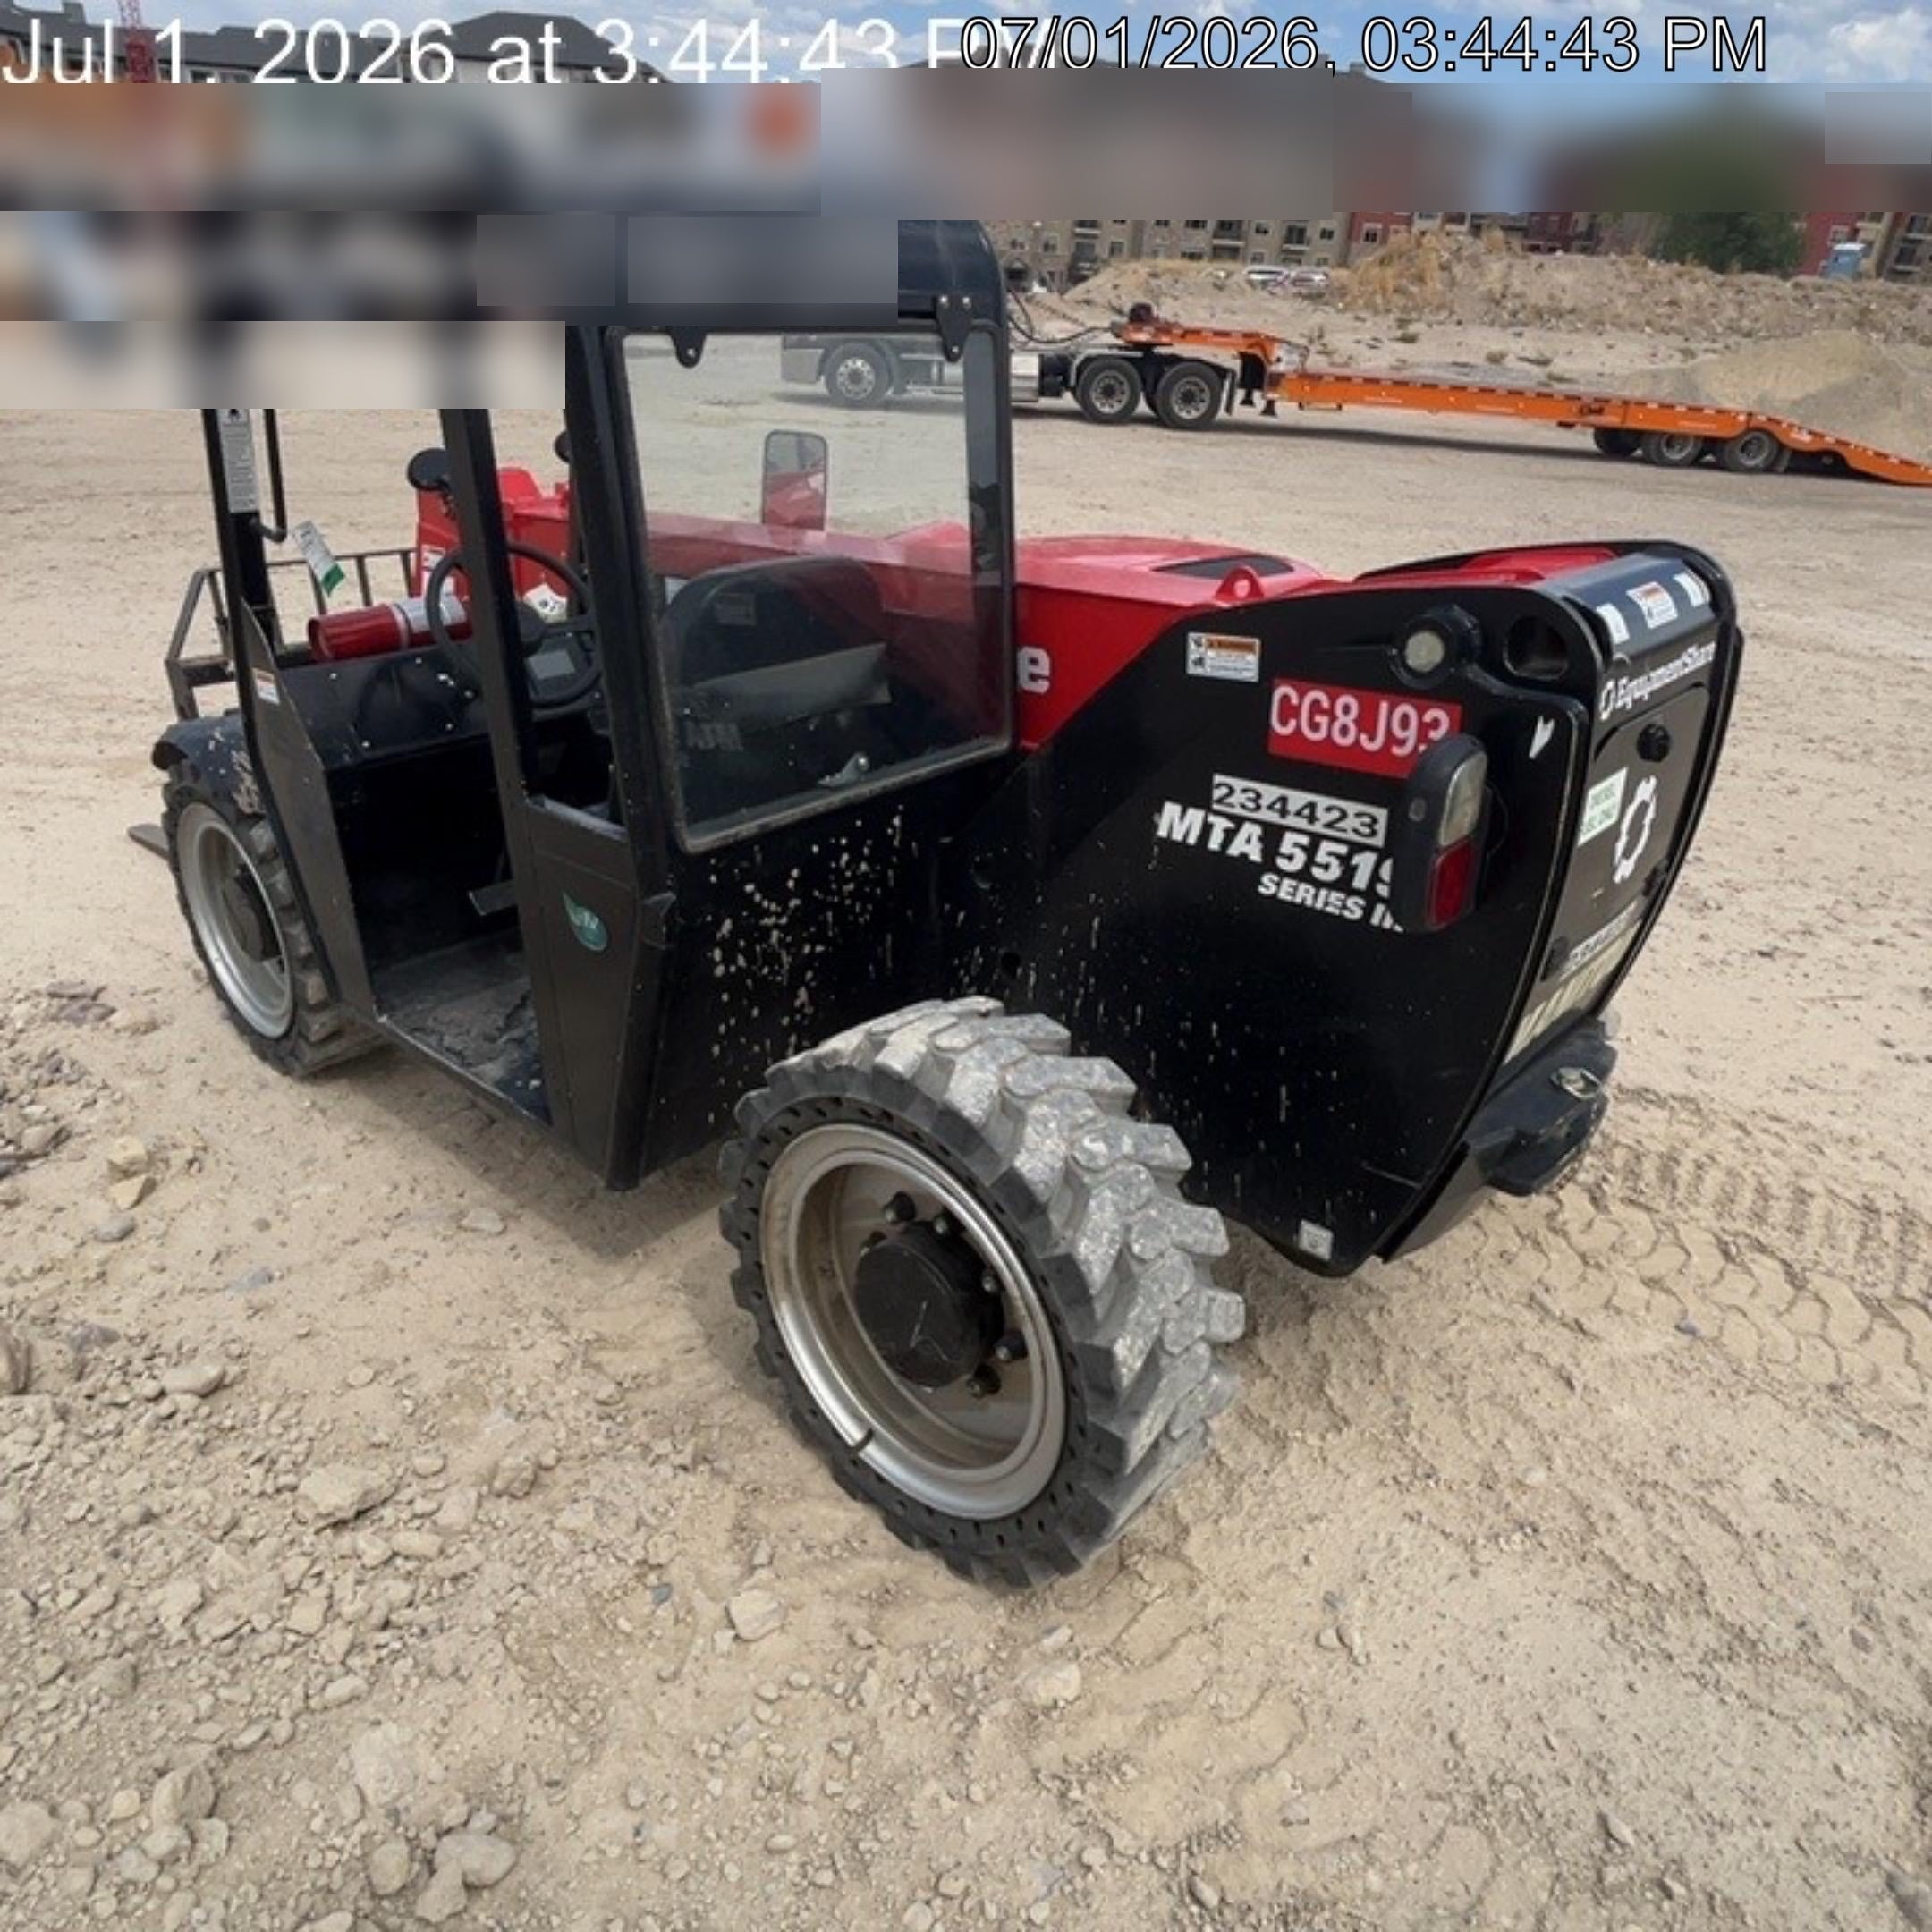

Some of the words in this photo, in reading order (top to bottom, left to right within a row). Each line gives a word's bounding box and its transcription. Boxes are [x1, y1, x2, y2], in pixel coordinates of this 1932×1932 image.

[1156, 801, 1263, 863] MTA
[1213, 783, 1379, 838] 234423
[1258, 873, 1367, 921] SERIES
